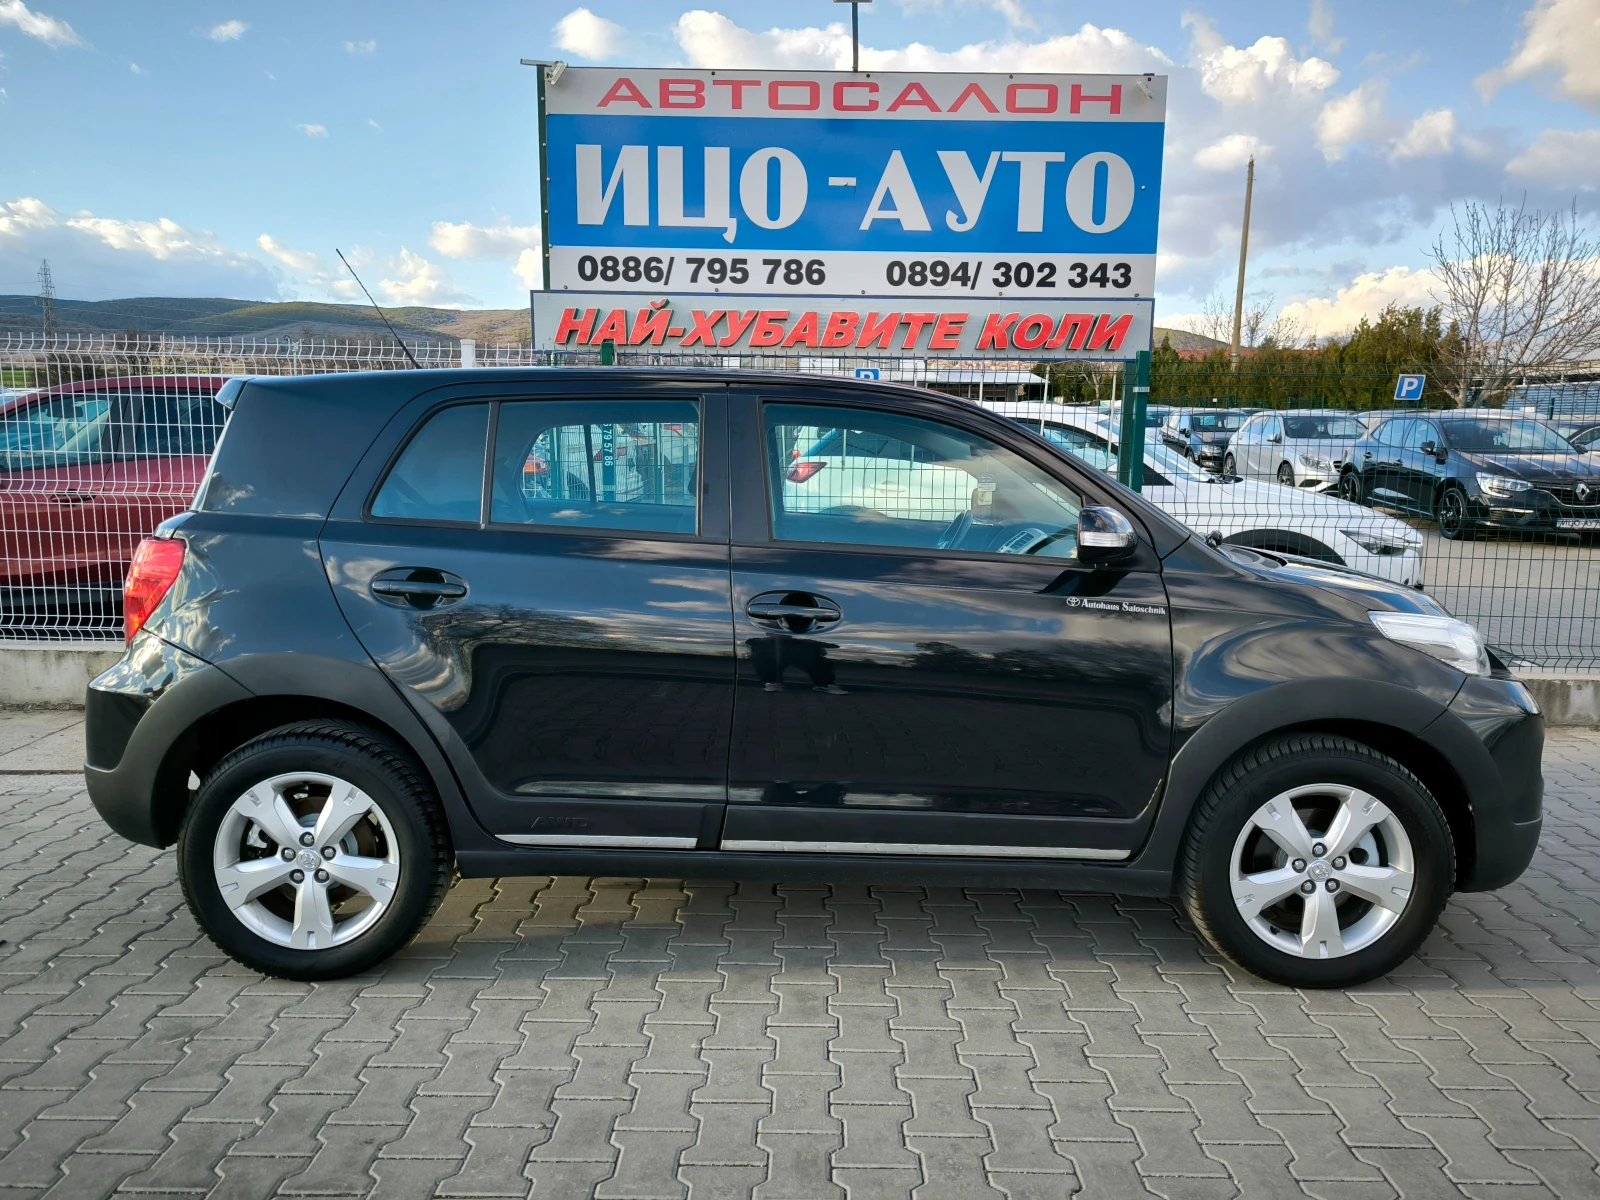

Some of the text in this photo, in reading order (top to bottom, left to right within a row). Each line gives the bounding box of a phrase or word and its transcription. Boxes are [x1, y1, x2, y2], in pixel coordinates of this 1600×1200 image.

[596, 77, 1122, 115] АВТОСАЛОН
[577, 255, 826, 286] 0886/ 795 786
[886, 260, 1132, 290] 0894/ 302 343
[553, 298, 1135, 350] НАЙ-ХУБАВИТЕ КОЛИ
[1400, 377, 1419, 397] P
[604, 430, 612, 440] 79
[604, 443, 612, 453] 57
[605, 456, 613, 466] 86
[1081, 598, 1120, 611] Autohaus
[530, 816, 589, 829] AWD
